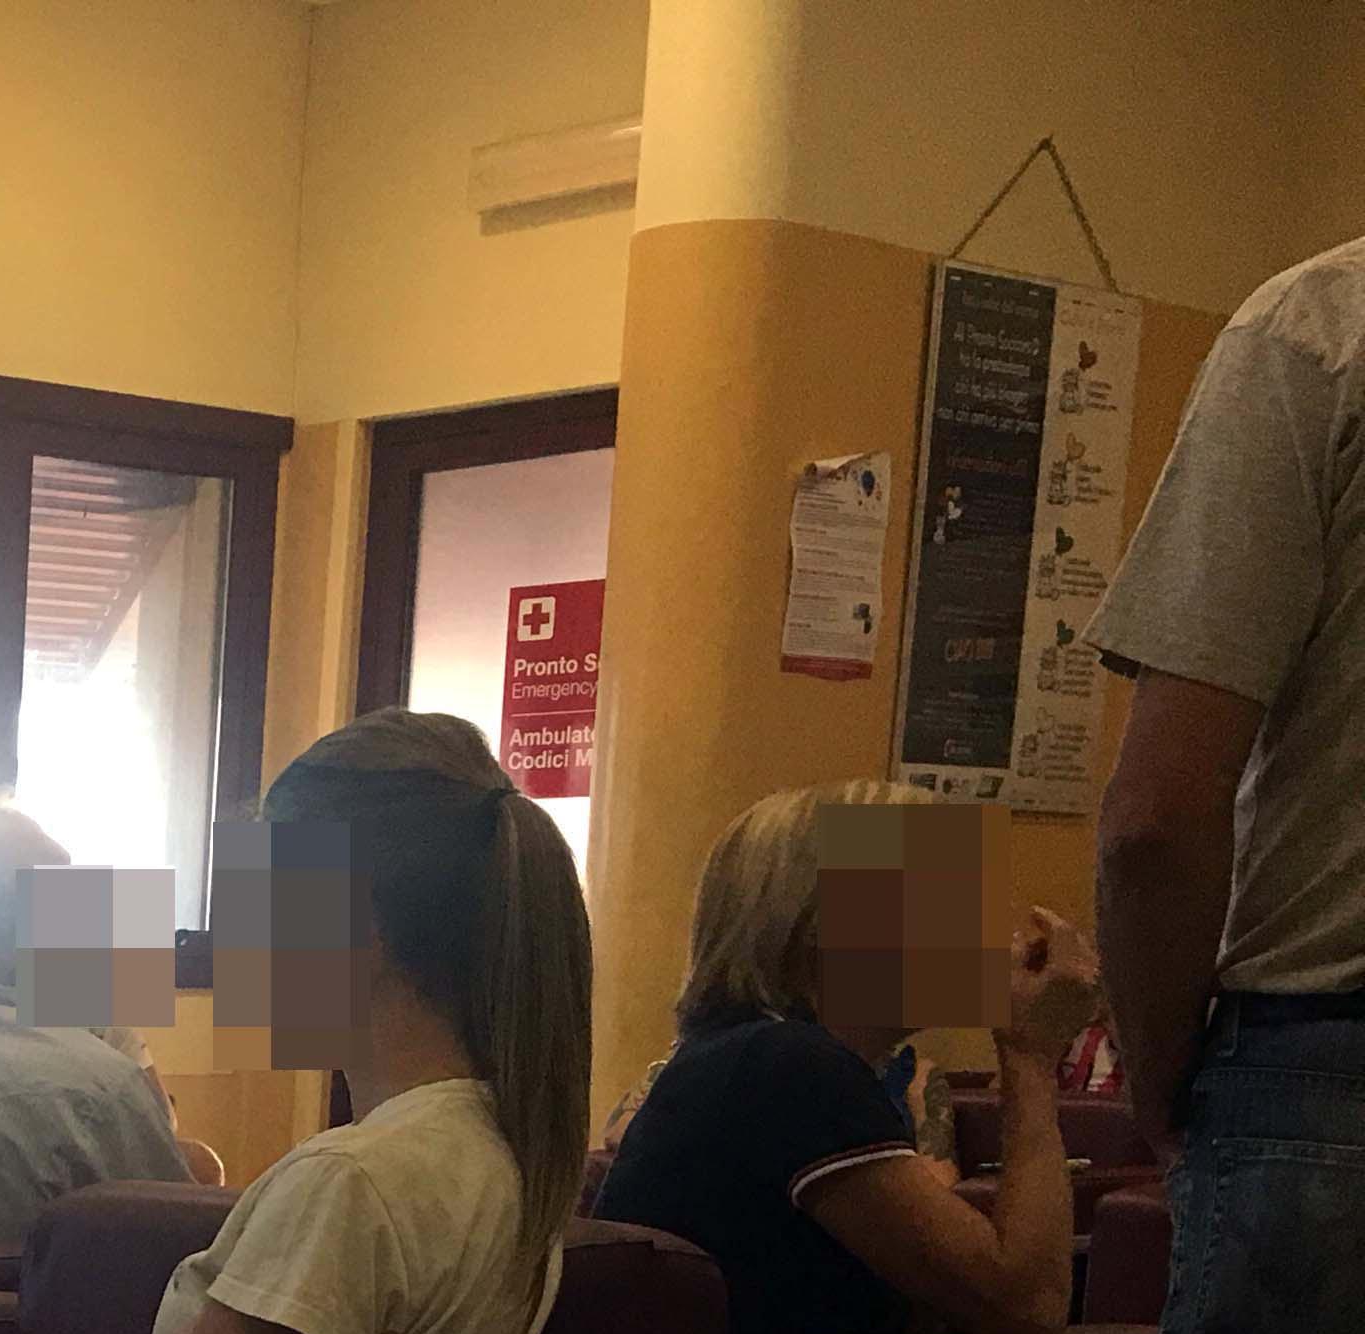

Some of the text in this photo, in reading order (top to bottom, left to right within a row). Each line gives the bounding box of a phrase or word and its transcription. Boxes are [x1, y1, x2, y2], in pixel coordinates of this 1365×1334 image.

[514, 653, 600, 677] Pronto S
[512, 680, 598, 701] Emergency
[508, 749, 569, 770] Codici
